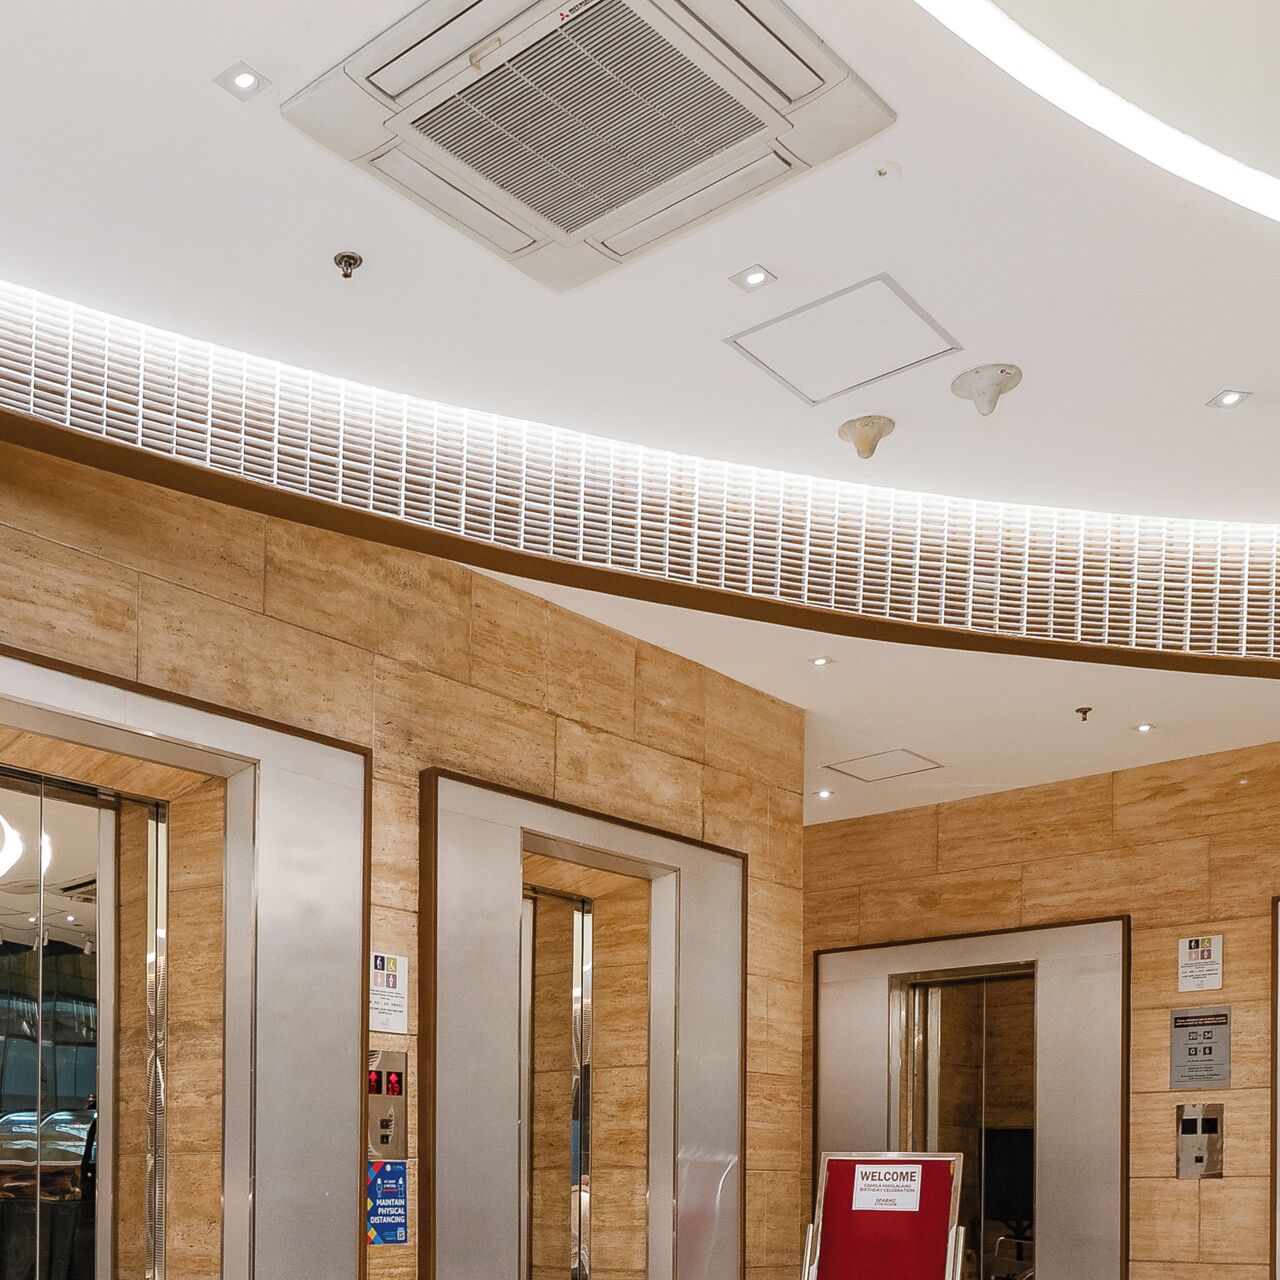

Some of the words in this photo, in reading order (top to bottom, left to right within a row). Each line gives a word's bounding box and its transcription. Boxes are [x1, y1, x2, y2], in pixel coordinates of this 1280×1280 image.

[860, 1171, 917, 1182] WELCOME
[376, 1198, 405, 1207] MAINTAIN
[377, 1207, 405, 1215] PHYSICAL
[370, 1215, 405, 1224] DISTANCING
